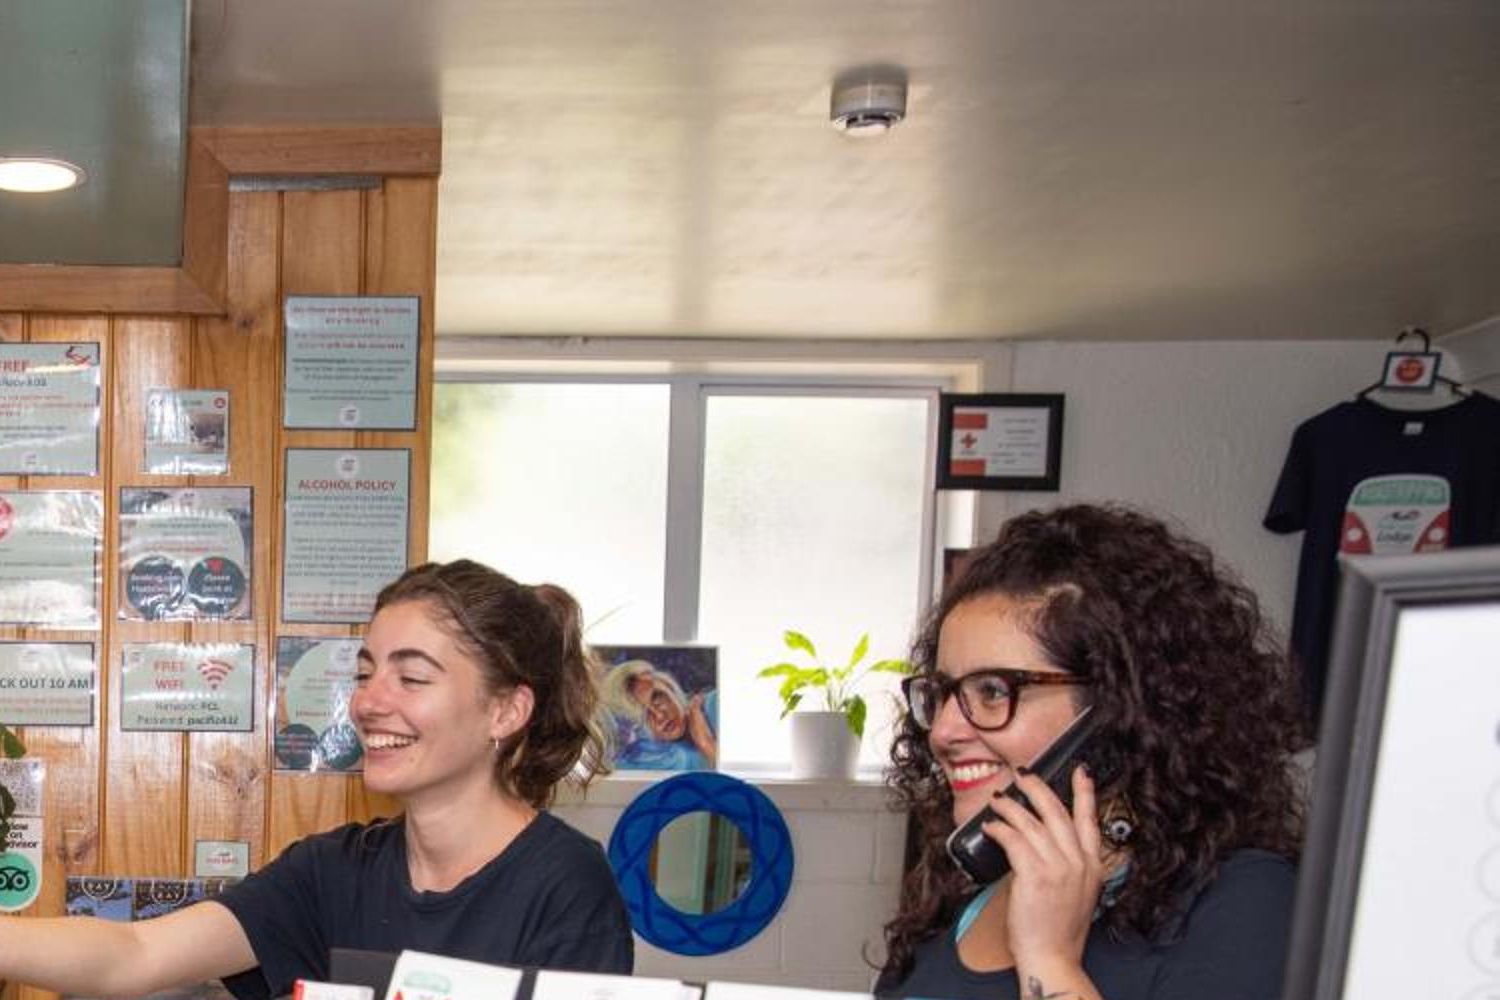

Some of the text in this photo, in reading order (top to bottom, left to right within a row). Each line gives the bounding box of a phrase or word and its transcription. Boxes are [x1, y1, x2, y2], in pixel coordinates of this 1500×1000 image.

[298, 480, 397, 491] ALCOHOL POLICY
[19, 677, 46, 689] OUT
[49, 677, 65, 689] 10
[67, 677, 89, 689] AM
